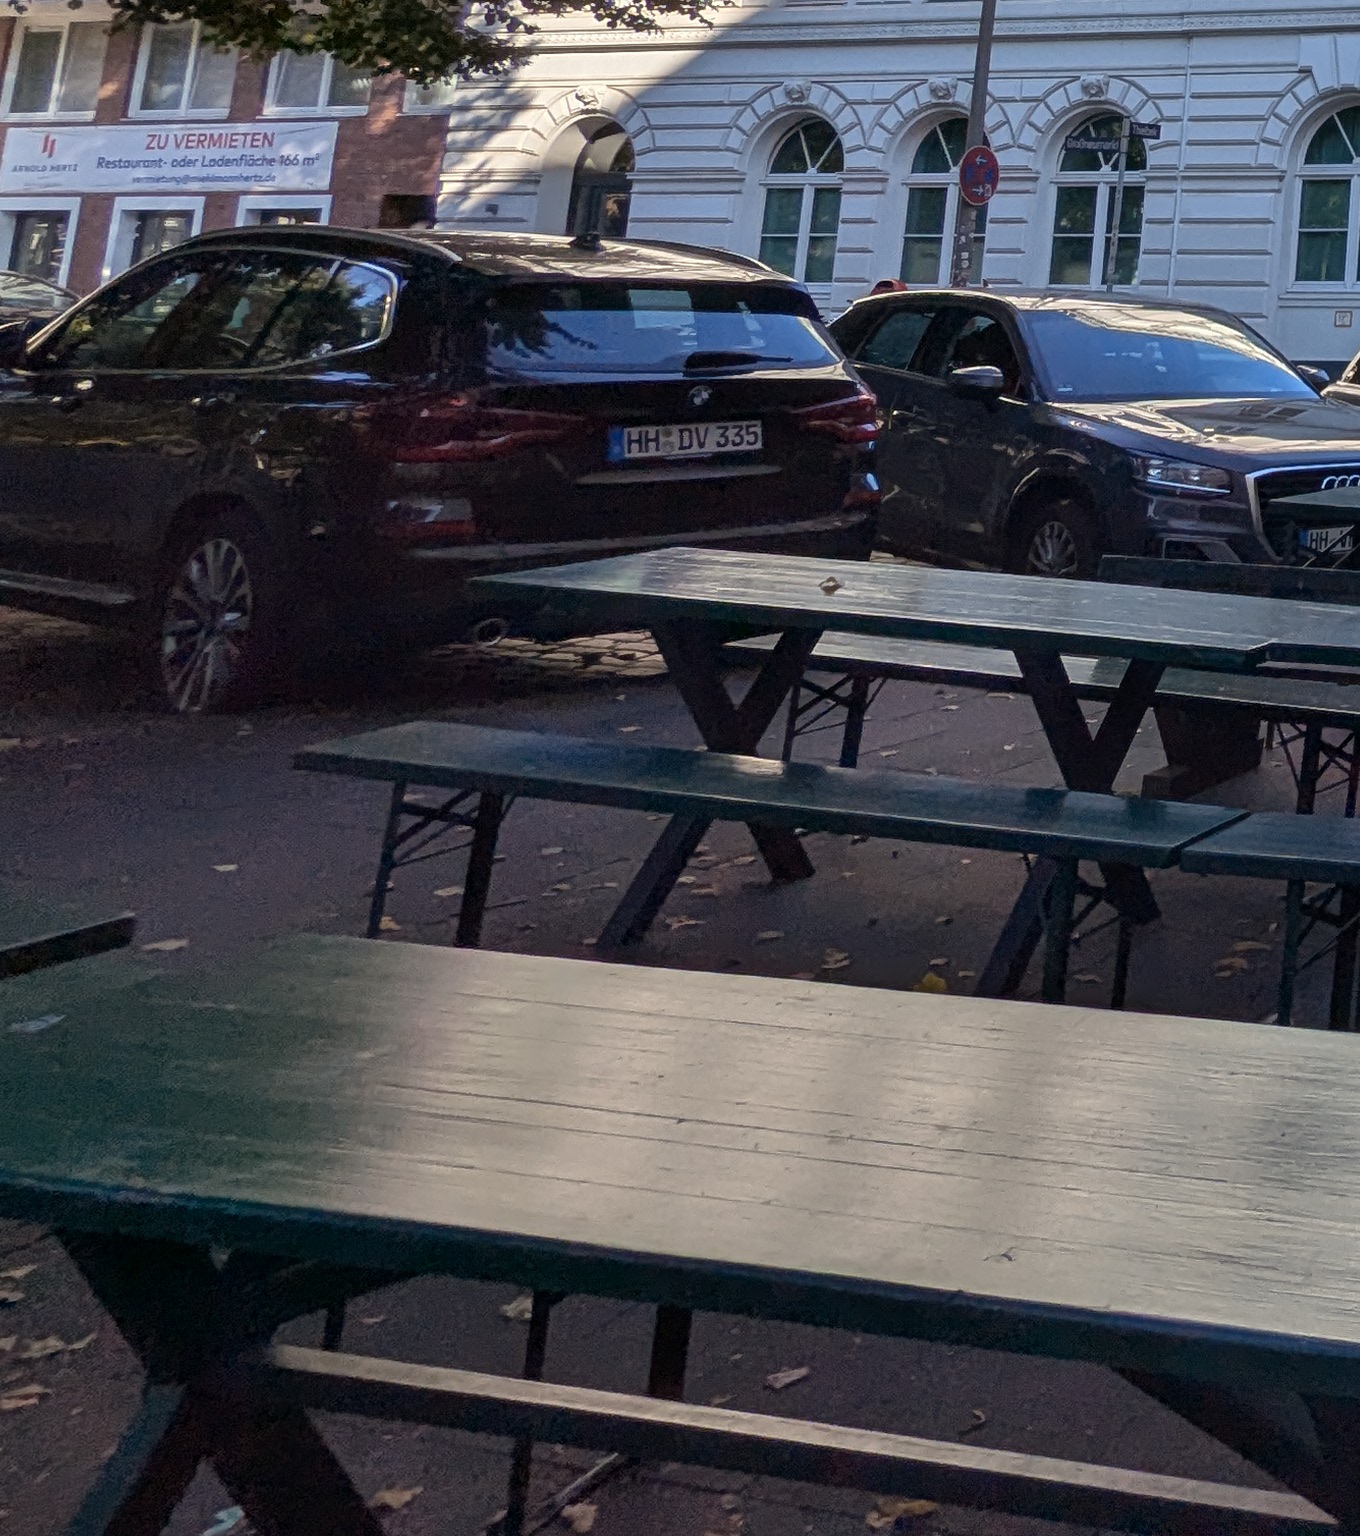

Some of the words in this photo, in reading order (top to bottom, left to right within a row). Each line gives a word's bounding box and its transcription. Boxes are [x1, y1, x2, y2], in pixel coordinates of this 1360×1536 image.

[145, 133, 168, 150] ZU
[174, 131, 275, 149] VERMIETEN
[96, 156, 167, 169] Restaurant-
[170, 155, 197, 168] oder
[201, 154, 276, 168] Ladenfläche
[279, 154, 300, 167] 166
[627, 430, 660, 454] HH
[678, 427, 709, 450] DV
[716, 424, 758, 448] 335
